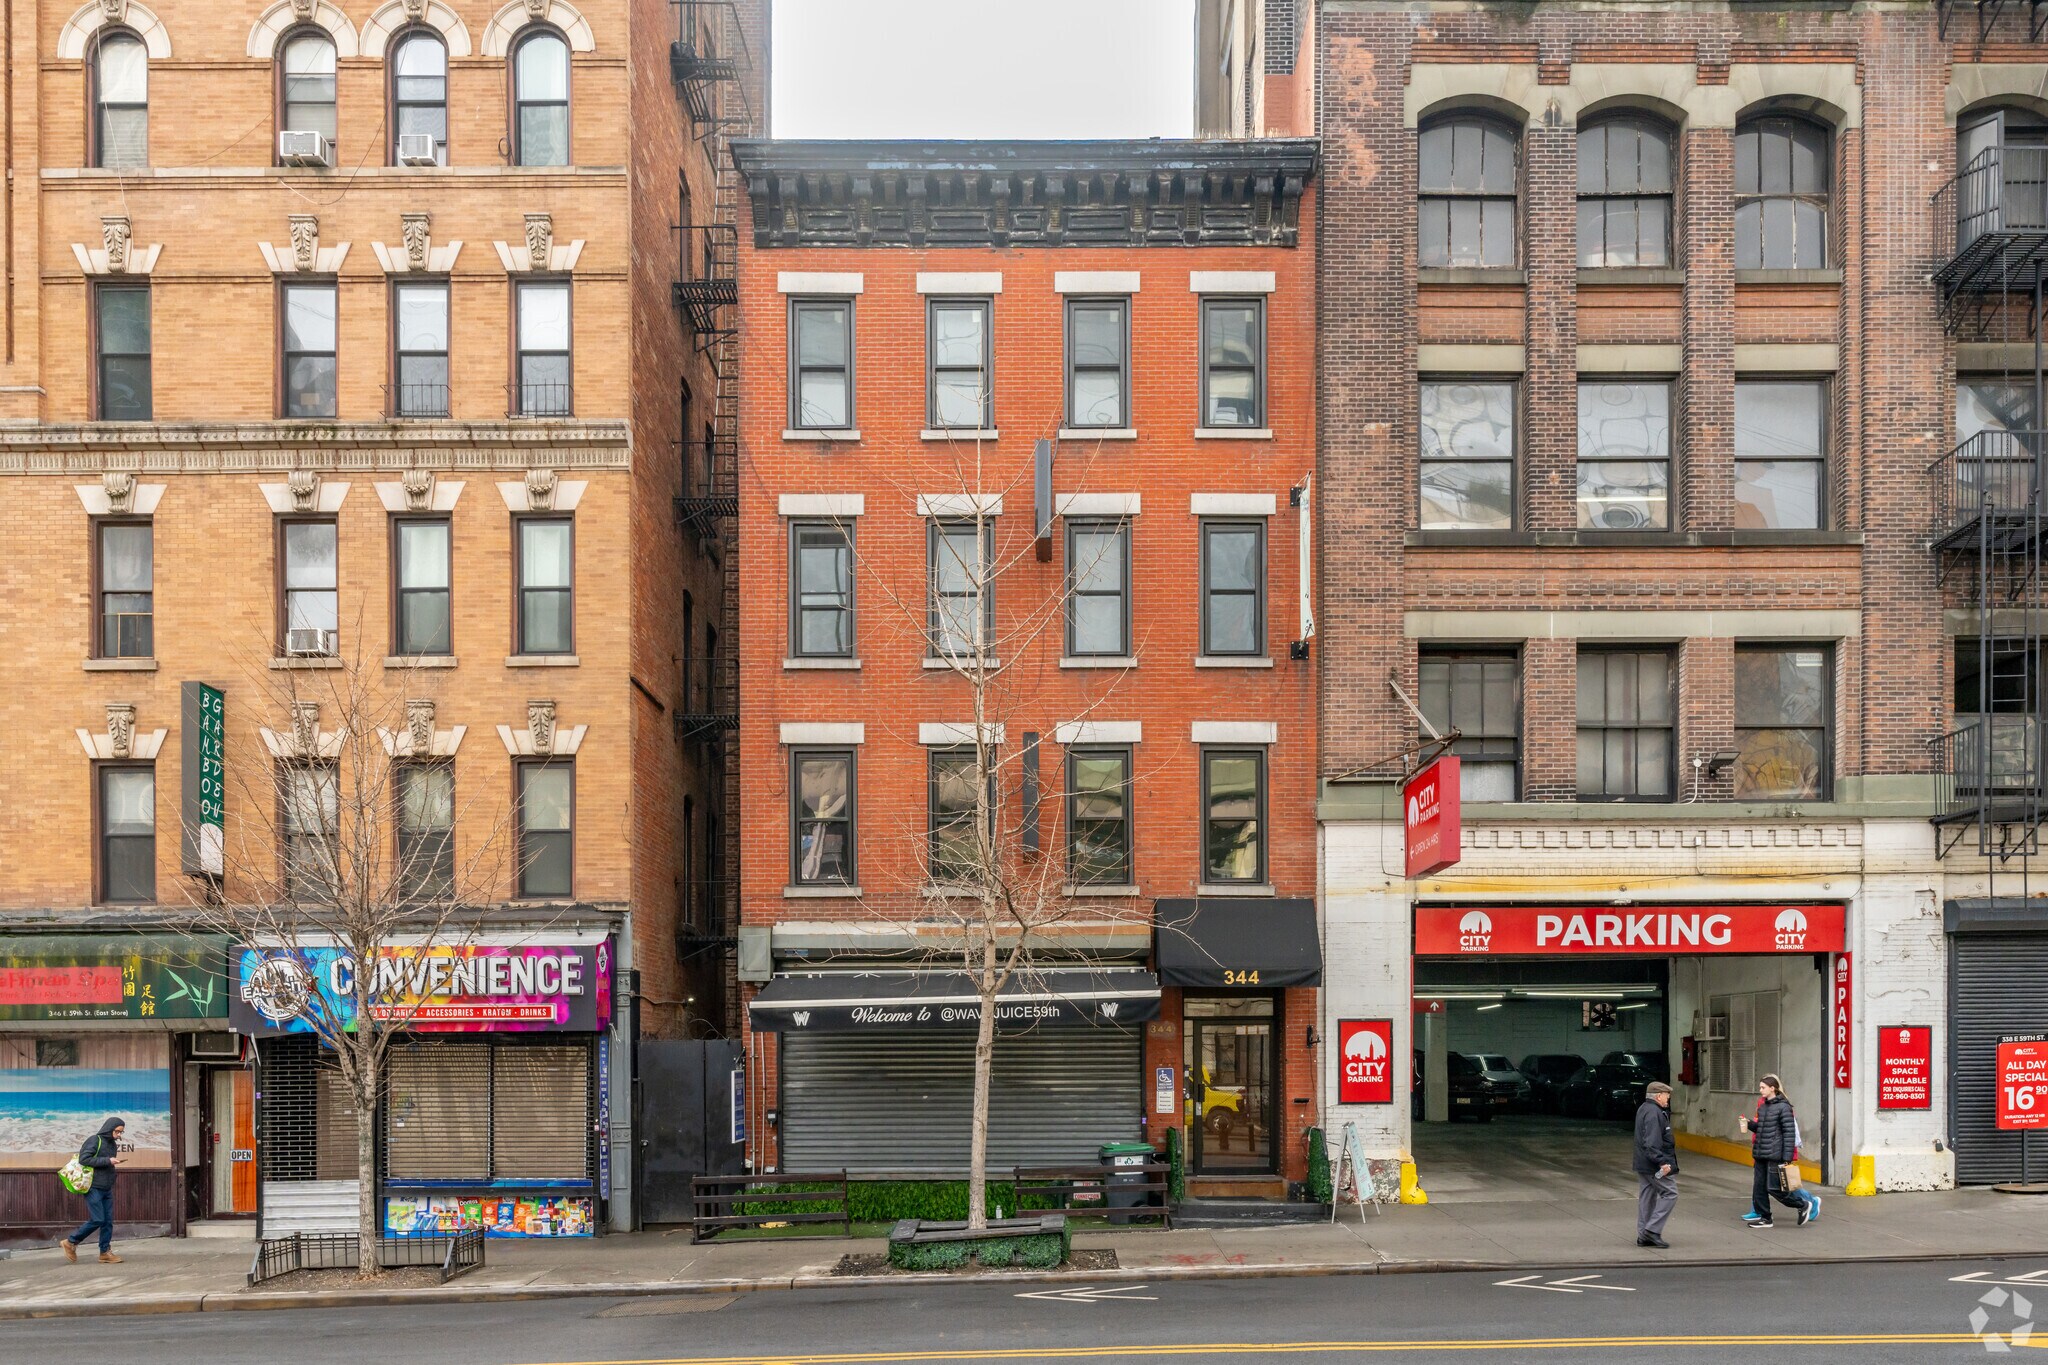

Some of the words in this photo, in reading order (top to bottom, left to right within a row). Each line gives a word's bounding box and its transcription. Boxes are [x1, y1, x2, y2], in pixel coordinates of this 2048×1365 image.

[202, 692, 212, 815] BAMBOO
[212, 699, 222, 819] GARDEN
[1419, 783, 1435, 810] CITY
[1420, 802, 1440, 824] PARKING
[1537, 914, 1732, 947] PARKING
[1460, 935, 1492, 946] CITY
[1775, 933, 1807, 945] CITY
[1224, 970, 1260, 985] 344
[110, 1009, 129, 1017] Store)
[426, 1008, 474, 1017] ACCESSORIES
[482, 1008, 512, 1017] KRATOM
[520, 1008, 547, 1016] DRINKS
[851, 1007, 913, 1024] Welcome
[917, 1006, 931, 1021] to
[941, 1006, 1061, 1022] @WAVJUICE59th
[1150, 1024, 1174, 1034] 344
[1837, 987, 1847, 1062] PARK
[1345, 1062, 1386, 1076] CITY
[2006, 1061, 2025, 1070] ALL
[2026, 1060, 2047, 1069] DAY
[2005, 1072, 2048, 1082] SPECIAL
[2004, 1086, 2035, 1110] 16
[2036, 1085, 2048, 1093] 90
[231, 1150, 253, 1160] OPEN
